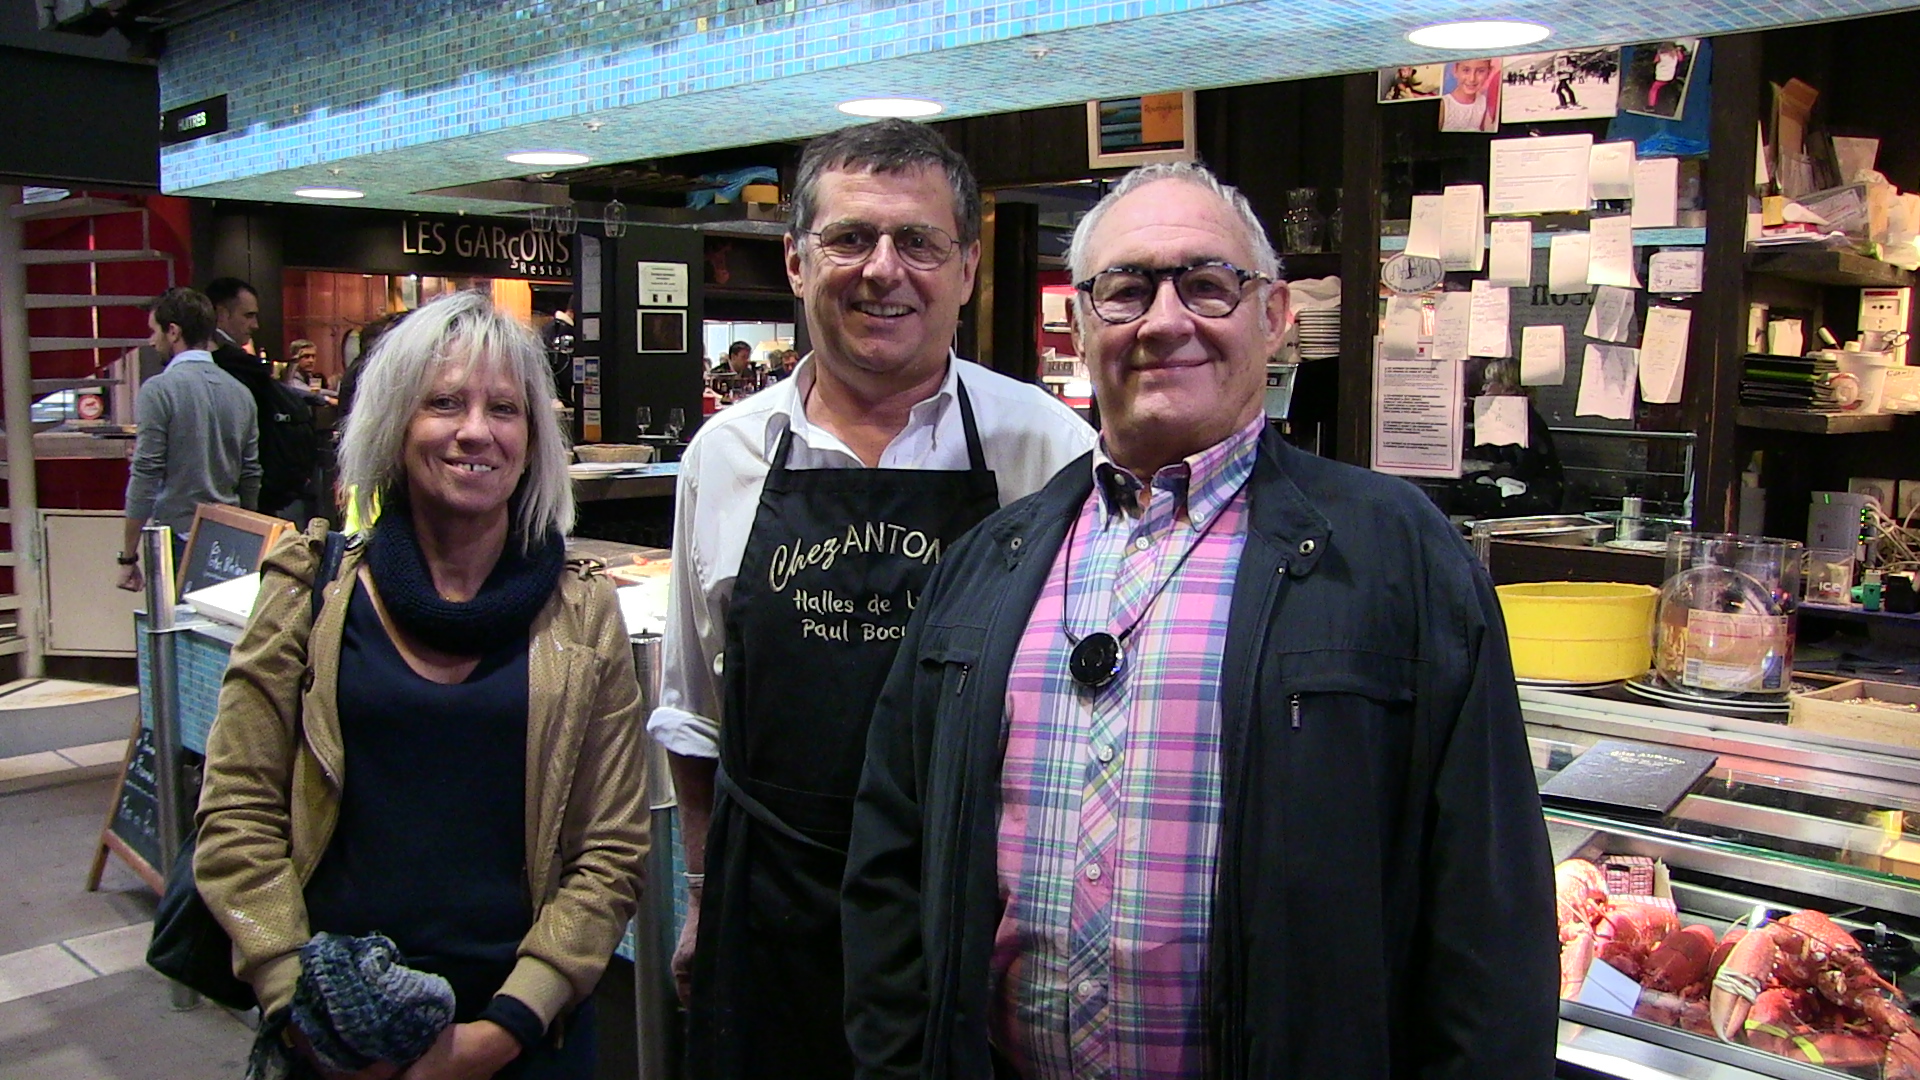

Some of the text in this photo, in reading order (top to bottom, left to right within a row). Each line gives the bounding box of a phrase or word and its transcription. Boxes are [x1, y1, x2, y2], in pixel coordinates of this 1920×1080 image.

[402, 220, 447, 255] LES
[768, 537, 842, 594] Chez
[792, 588, 854, 616] Halles
[867, 593, 892, 616] de
[801, 618, 850, 642] Paul
